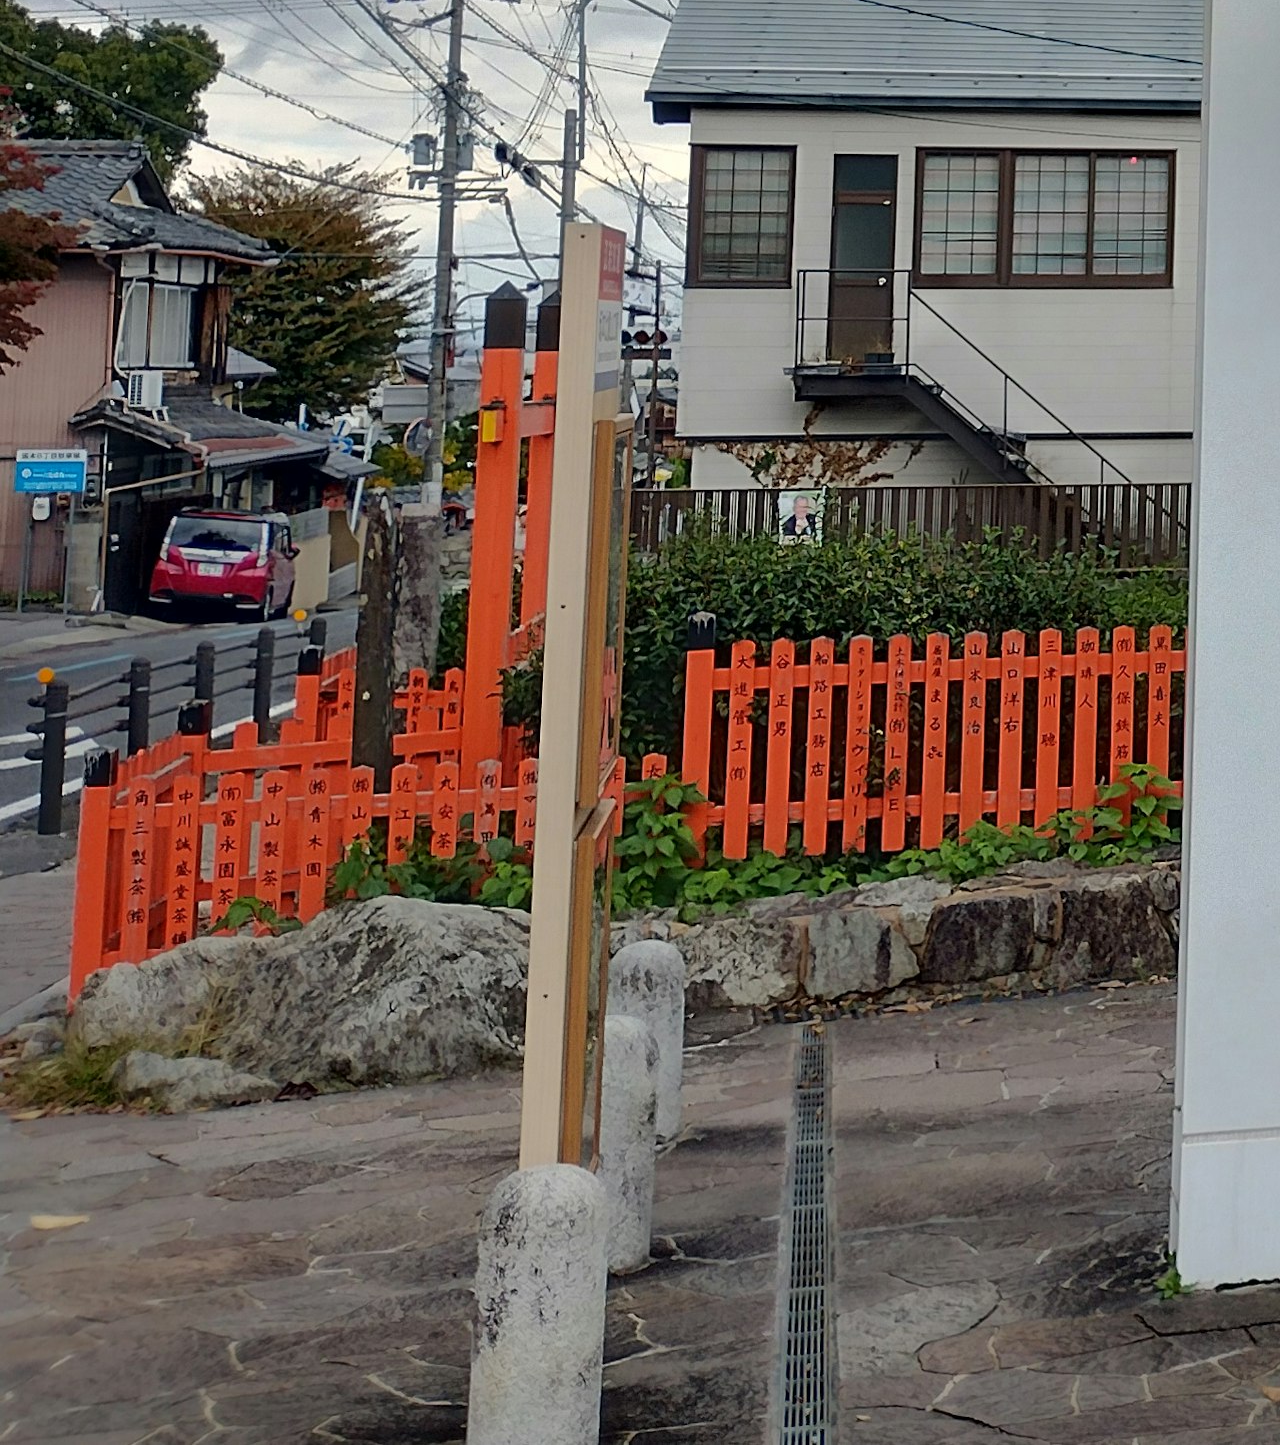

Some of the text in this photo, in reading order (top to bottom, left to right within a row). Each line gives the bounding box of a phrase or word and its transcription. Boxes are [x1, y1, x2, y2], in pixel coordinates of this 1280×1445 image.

[771, 654, 790, 738] 谷正男
[1079, 640, 1095, 709] 珈琲人
